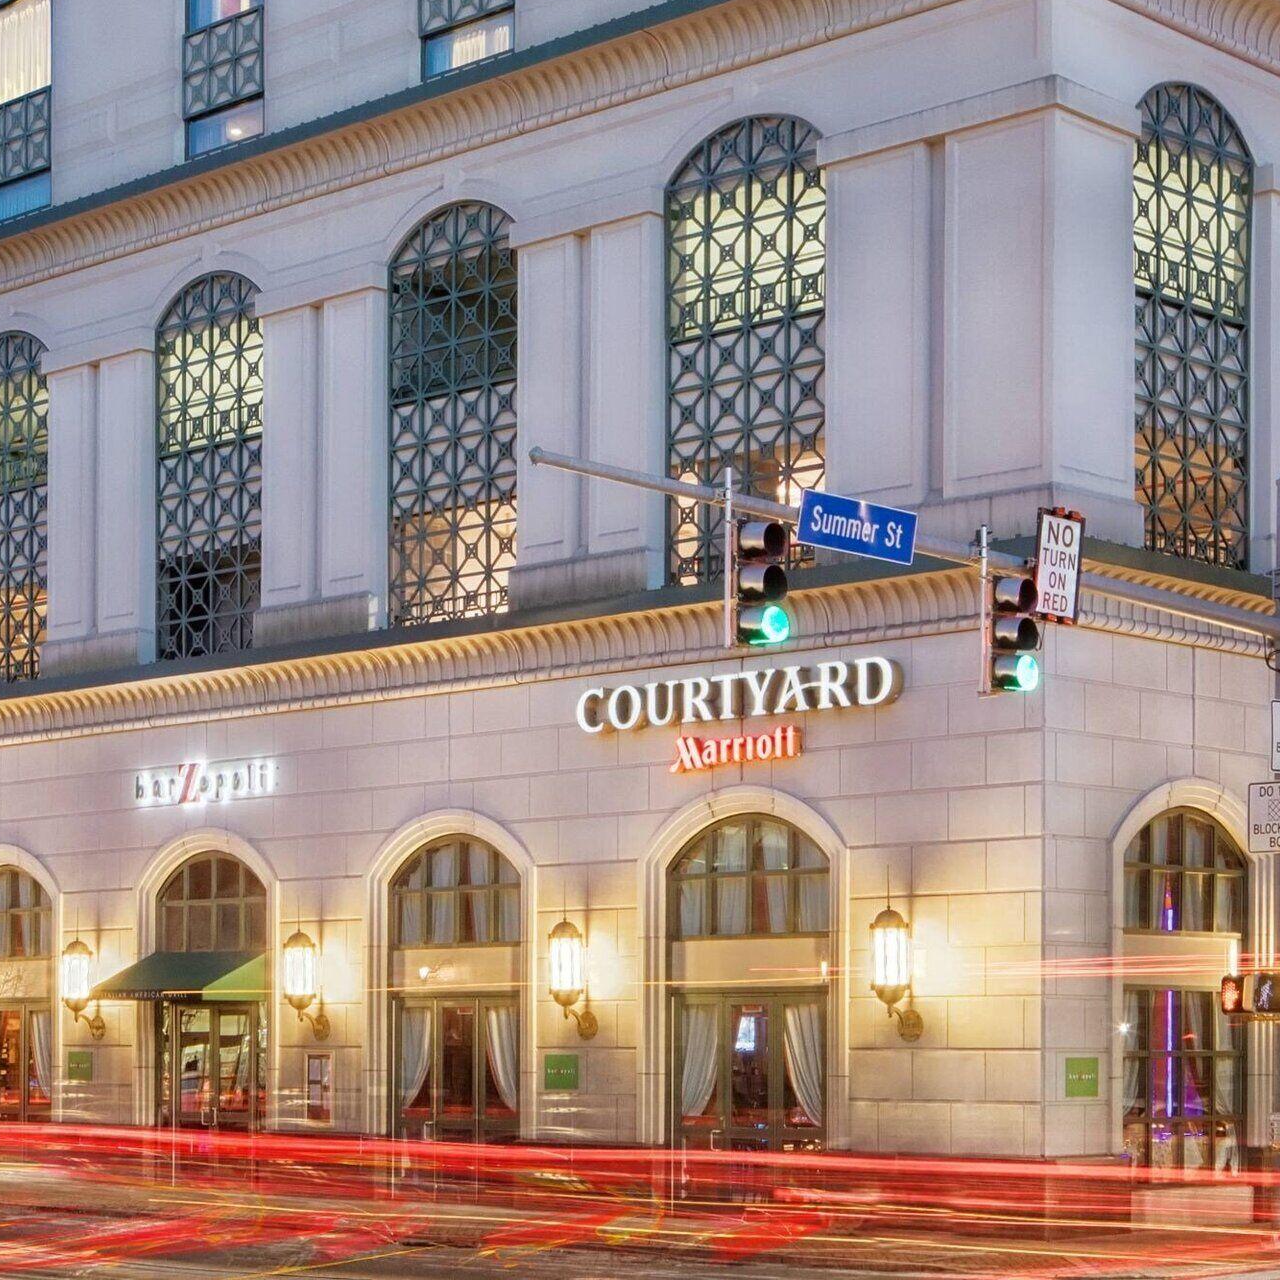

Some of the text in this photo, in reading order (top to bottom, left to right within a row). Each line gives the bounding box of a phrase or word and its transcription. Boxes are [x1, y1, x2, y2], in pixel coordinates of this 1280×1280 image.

[811, 504, 903, 549] Summer St
[1047, 521, 1074, 548] NO
[1043, 547, 1076, 571] TURN
[1049, 571, 1067, 591] ON
[1042, 592, 1068, 613] RED
[576, 656, 893, 733] COURTYARD
[670, 724, 796, 773] Marriott
[1259, 785, 1274, 798] DO
